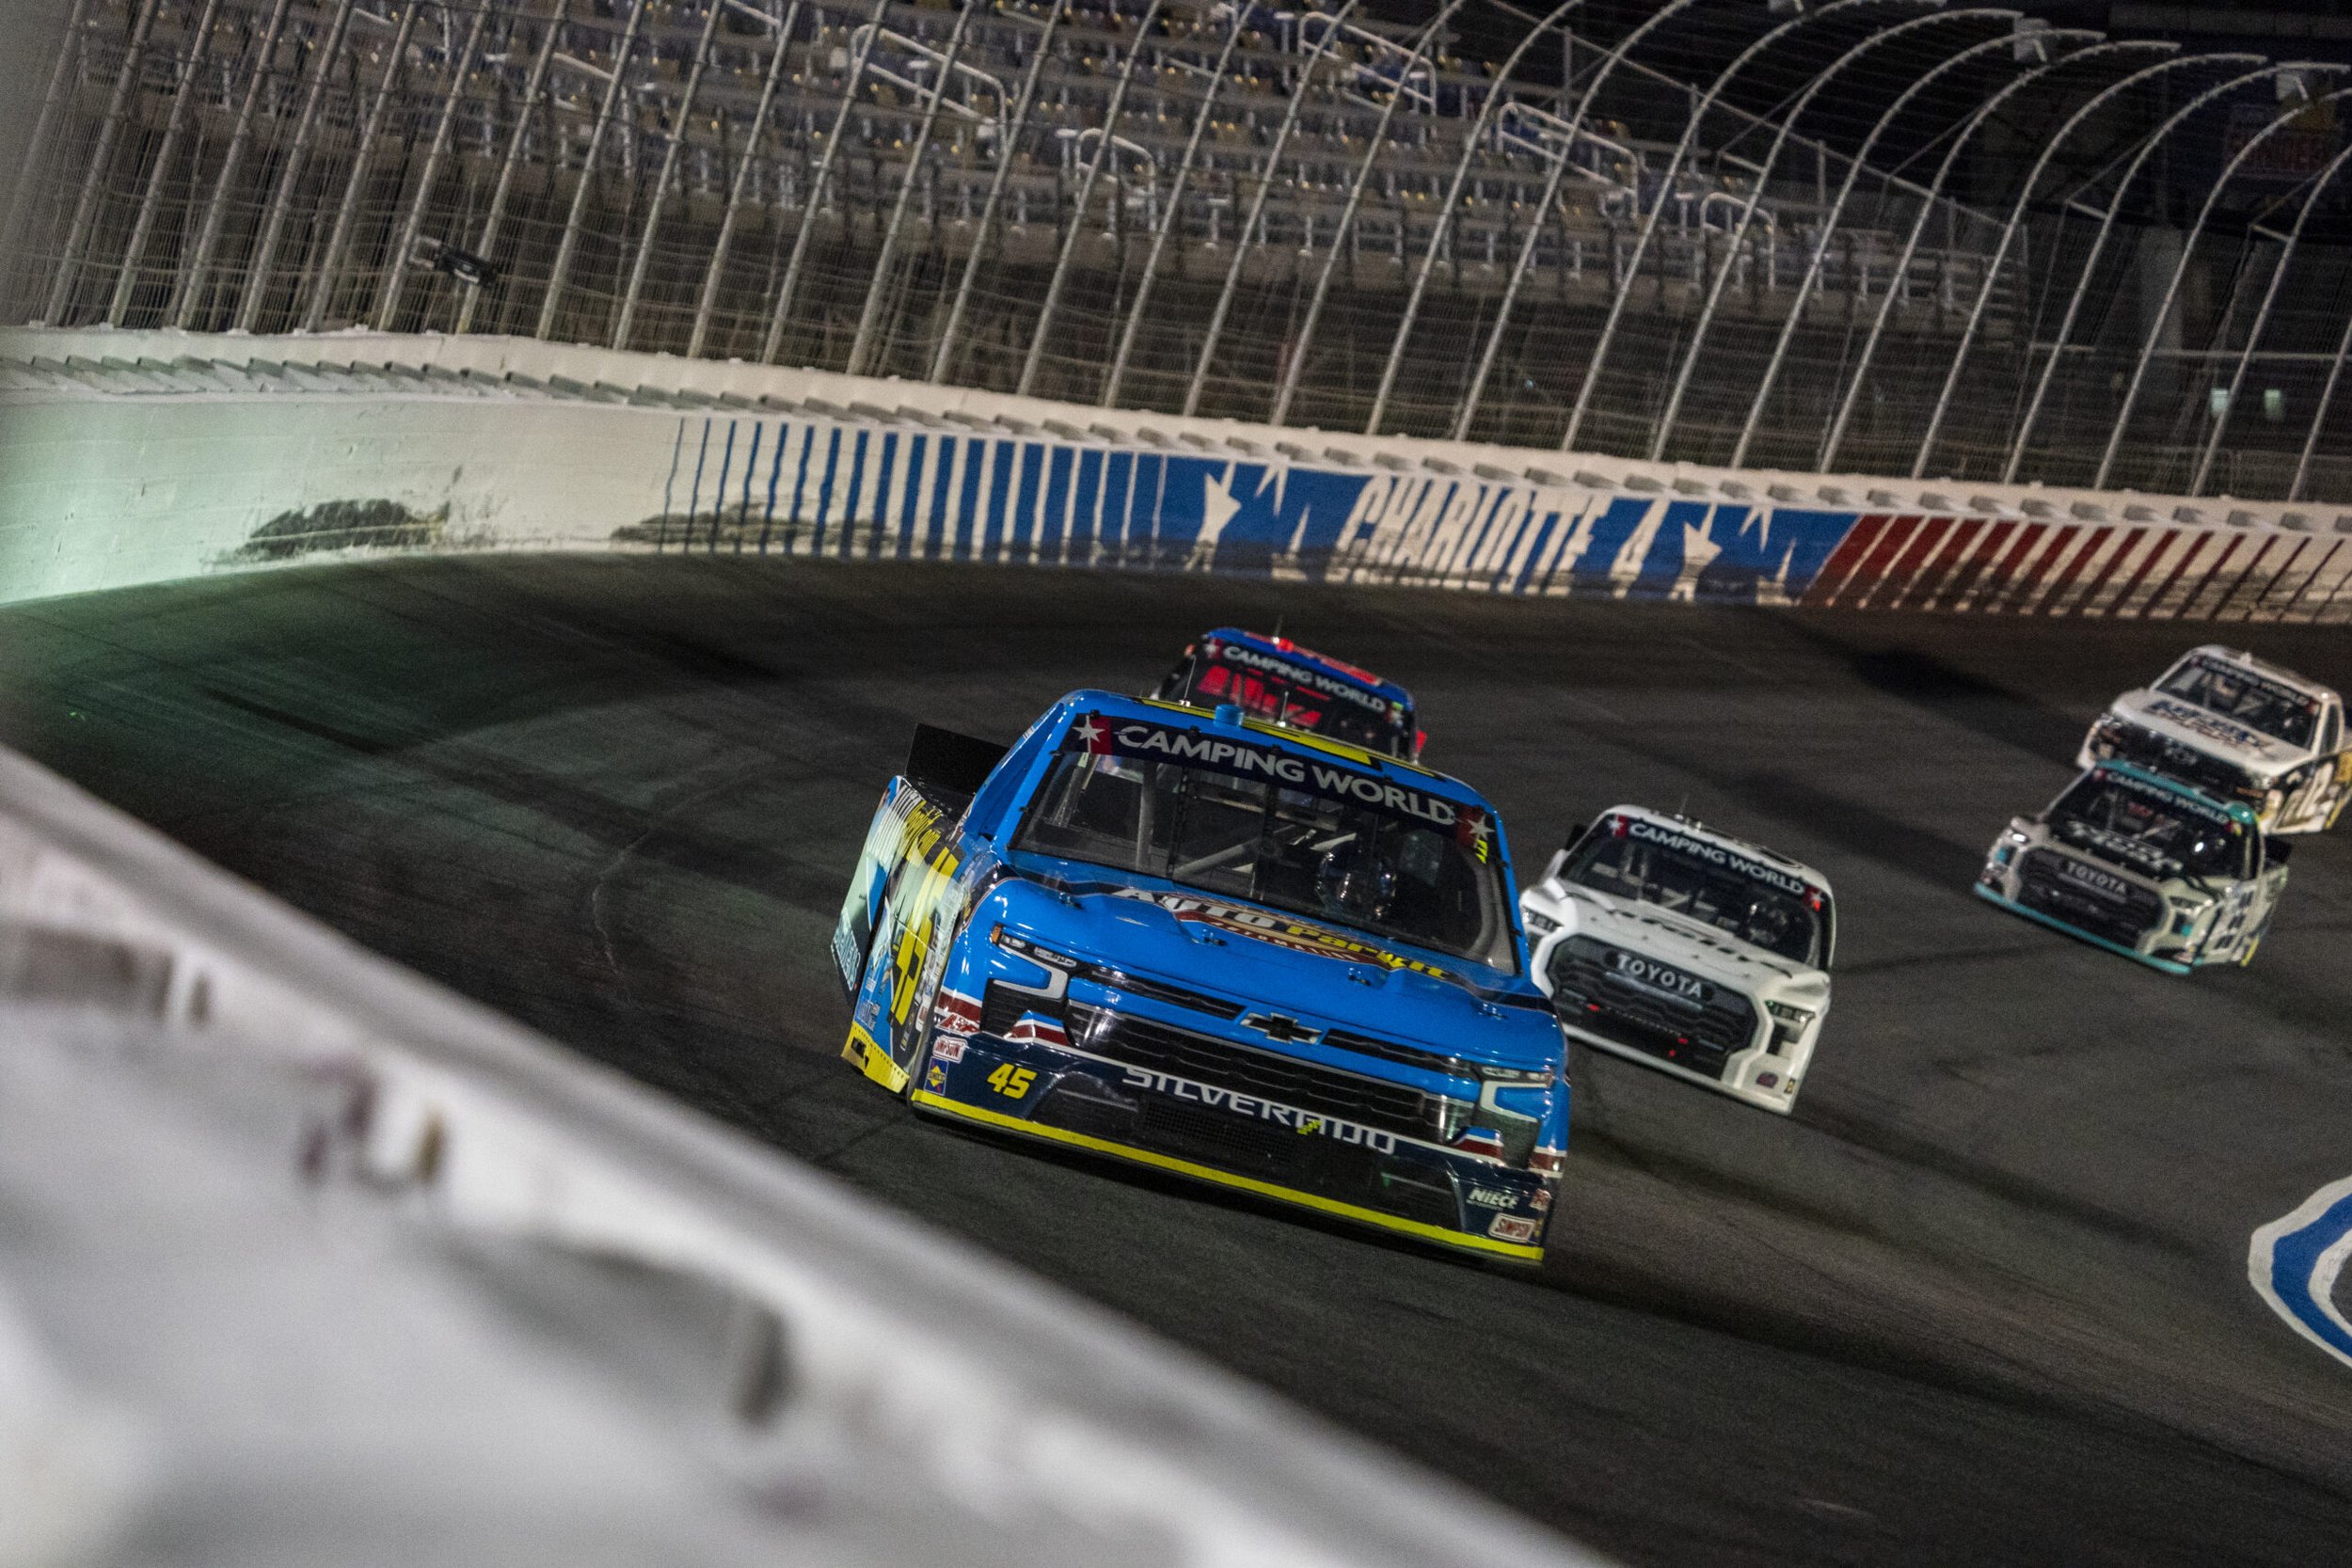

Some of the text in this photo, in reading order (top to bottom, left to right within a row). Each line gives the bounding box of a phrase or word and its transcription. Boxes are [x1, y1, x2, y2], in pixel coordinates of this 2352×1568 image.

[1324, 476, 1615, 598] CHARLOTTE
[1223, 645, 1387, 713] CAMPING WORLD
[1116, 724, 1456, 827] CAMPING WORLD
[1629, 823, 1805, 895] CAMPING WORLD
[2067, 861, 2127, 896] TOYOTA
[1616, 953, 1703, 999] TOYOTA
[986, 1062, 1038, 1100] 45
[1121, 1066, 1396, 1155] SILVERADO
